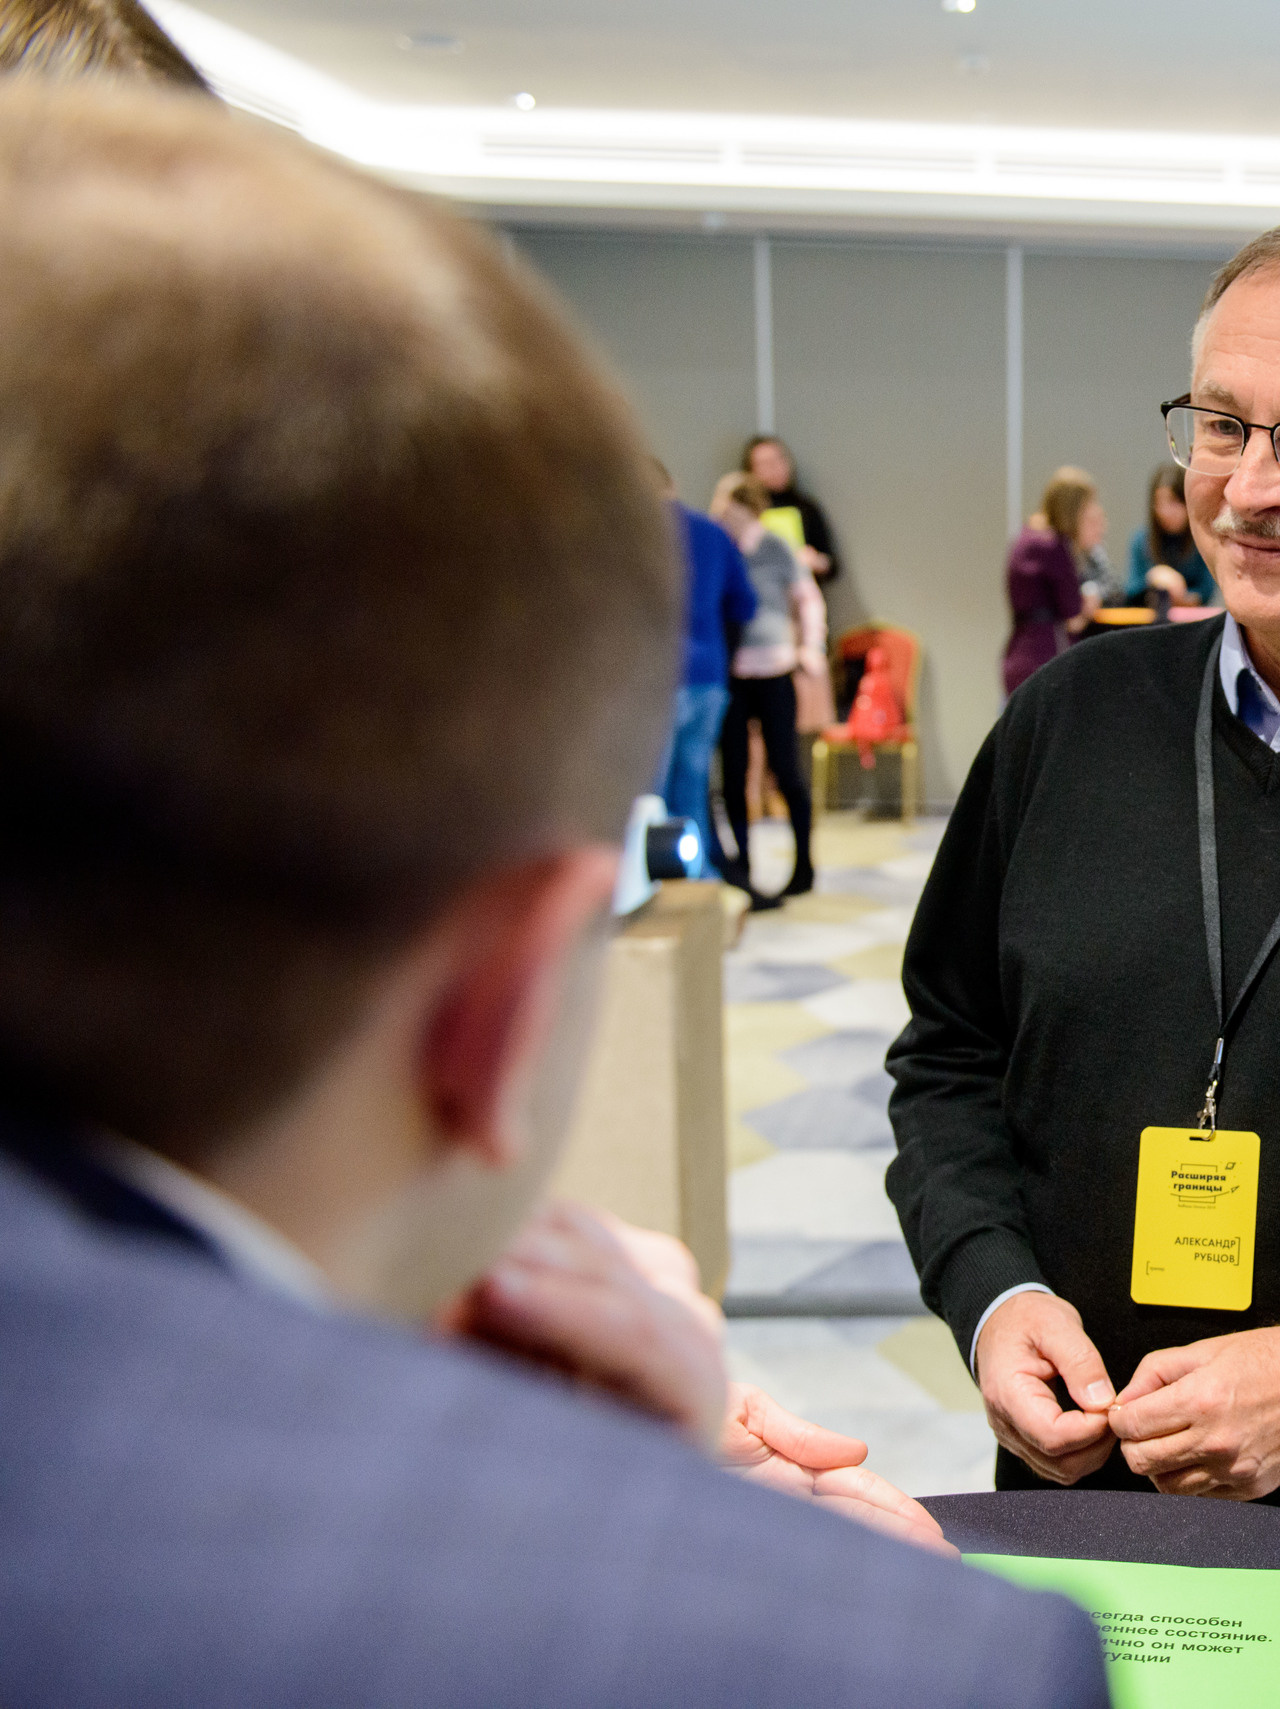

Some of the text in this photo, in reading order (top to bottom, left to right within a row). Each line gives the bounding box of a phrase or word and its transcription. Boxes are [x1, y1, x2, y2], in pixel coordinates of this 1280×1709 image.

[1171, 1170, 1226, 1182] Расширяя
[1173, 1183, 1222, 1192] границы
[1174, 1236, 1236, 1249] АЛЕКСАНДР
[1194, 1252, 1236, 1264] РУБЦОВ
[1090, 1611, 1243, 1628] сегда способен
[1164, 1629, 1273, 1642] состояние.
[1151, 1641, 1175, 1650] он
[1181, 1644, 1244, 1654] может
